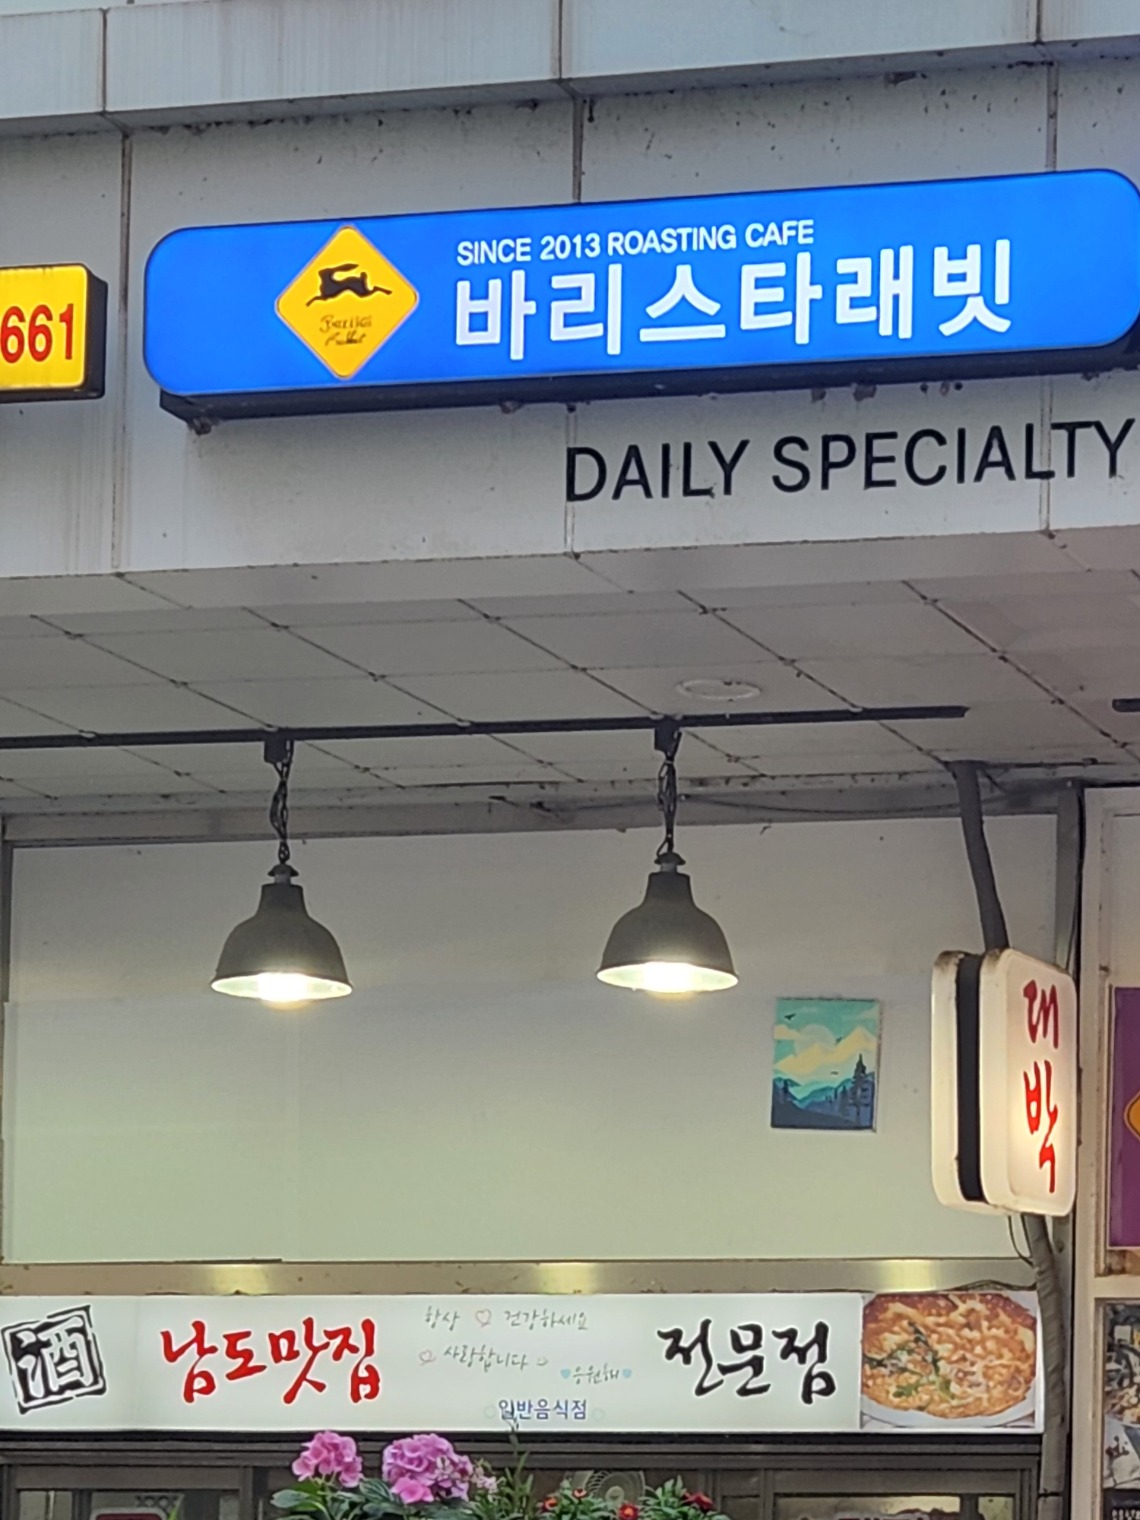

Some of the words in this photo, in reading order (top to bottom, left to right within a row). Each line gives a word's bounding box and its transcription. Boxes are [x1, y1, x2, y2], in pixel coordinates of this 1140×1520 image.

[456, 237, 532, 266] SINCE
[539, 232, 601, 261] 2013
[607, 224, 738, 257] ROASTING
[745, 219, 814, 249] CAFE
[0, 303, 75, 364] 661
[454, 239, 1012, 360] 바리스타래빗
[565, 438, 751, 502] DAILY
[771, 417, 1136, 494] SPECIALTY
[1022, 978, 1059, 1194] 대박
[17, 1316, 92, 1399] 酒
[160, 1316, 382, 1404] 남도맛집
[443, 1344, 529, 1373] 사랑합니다
[503, 1308, 589, 1331] 건강하세요
[656, 1317, 837, 1405] 전문점
[498, 1398, 587, 1420] 일반음식점
